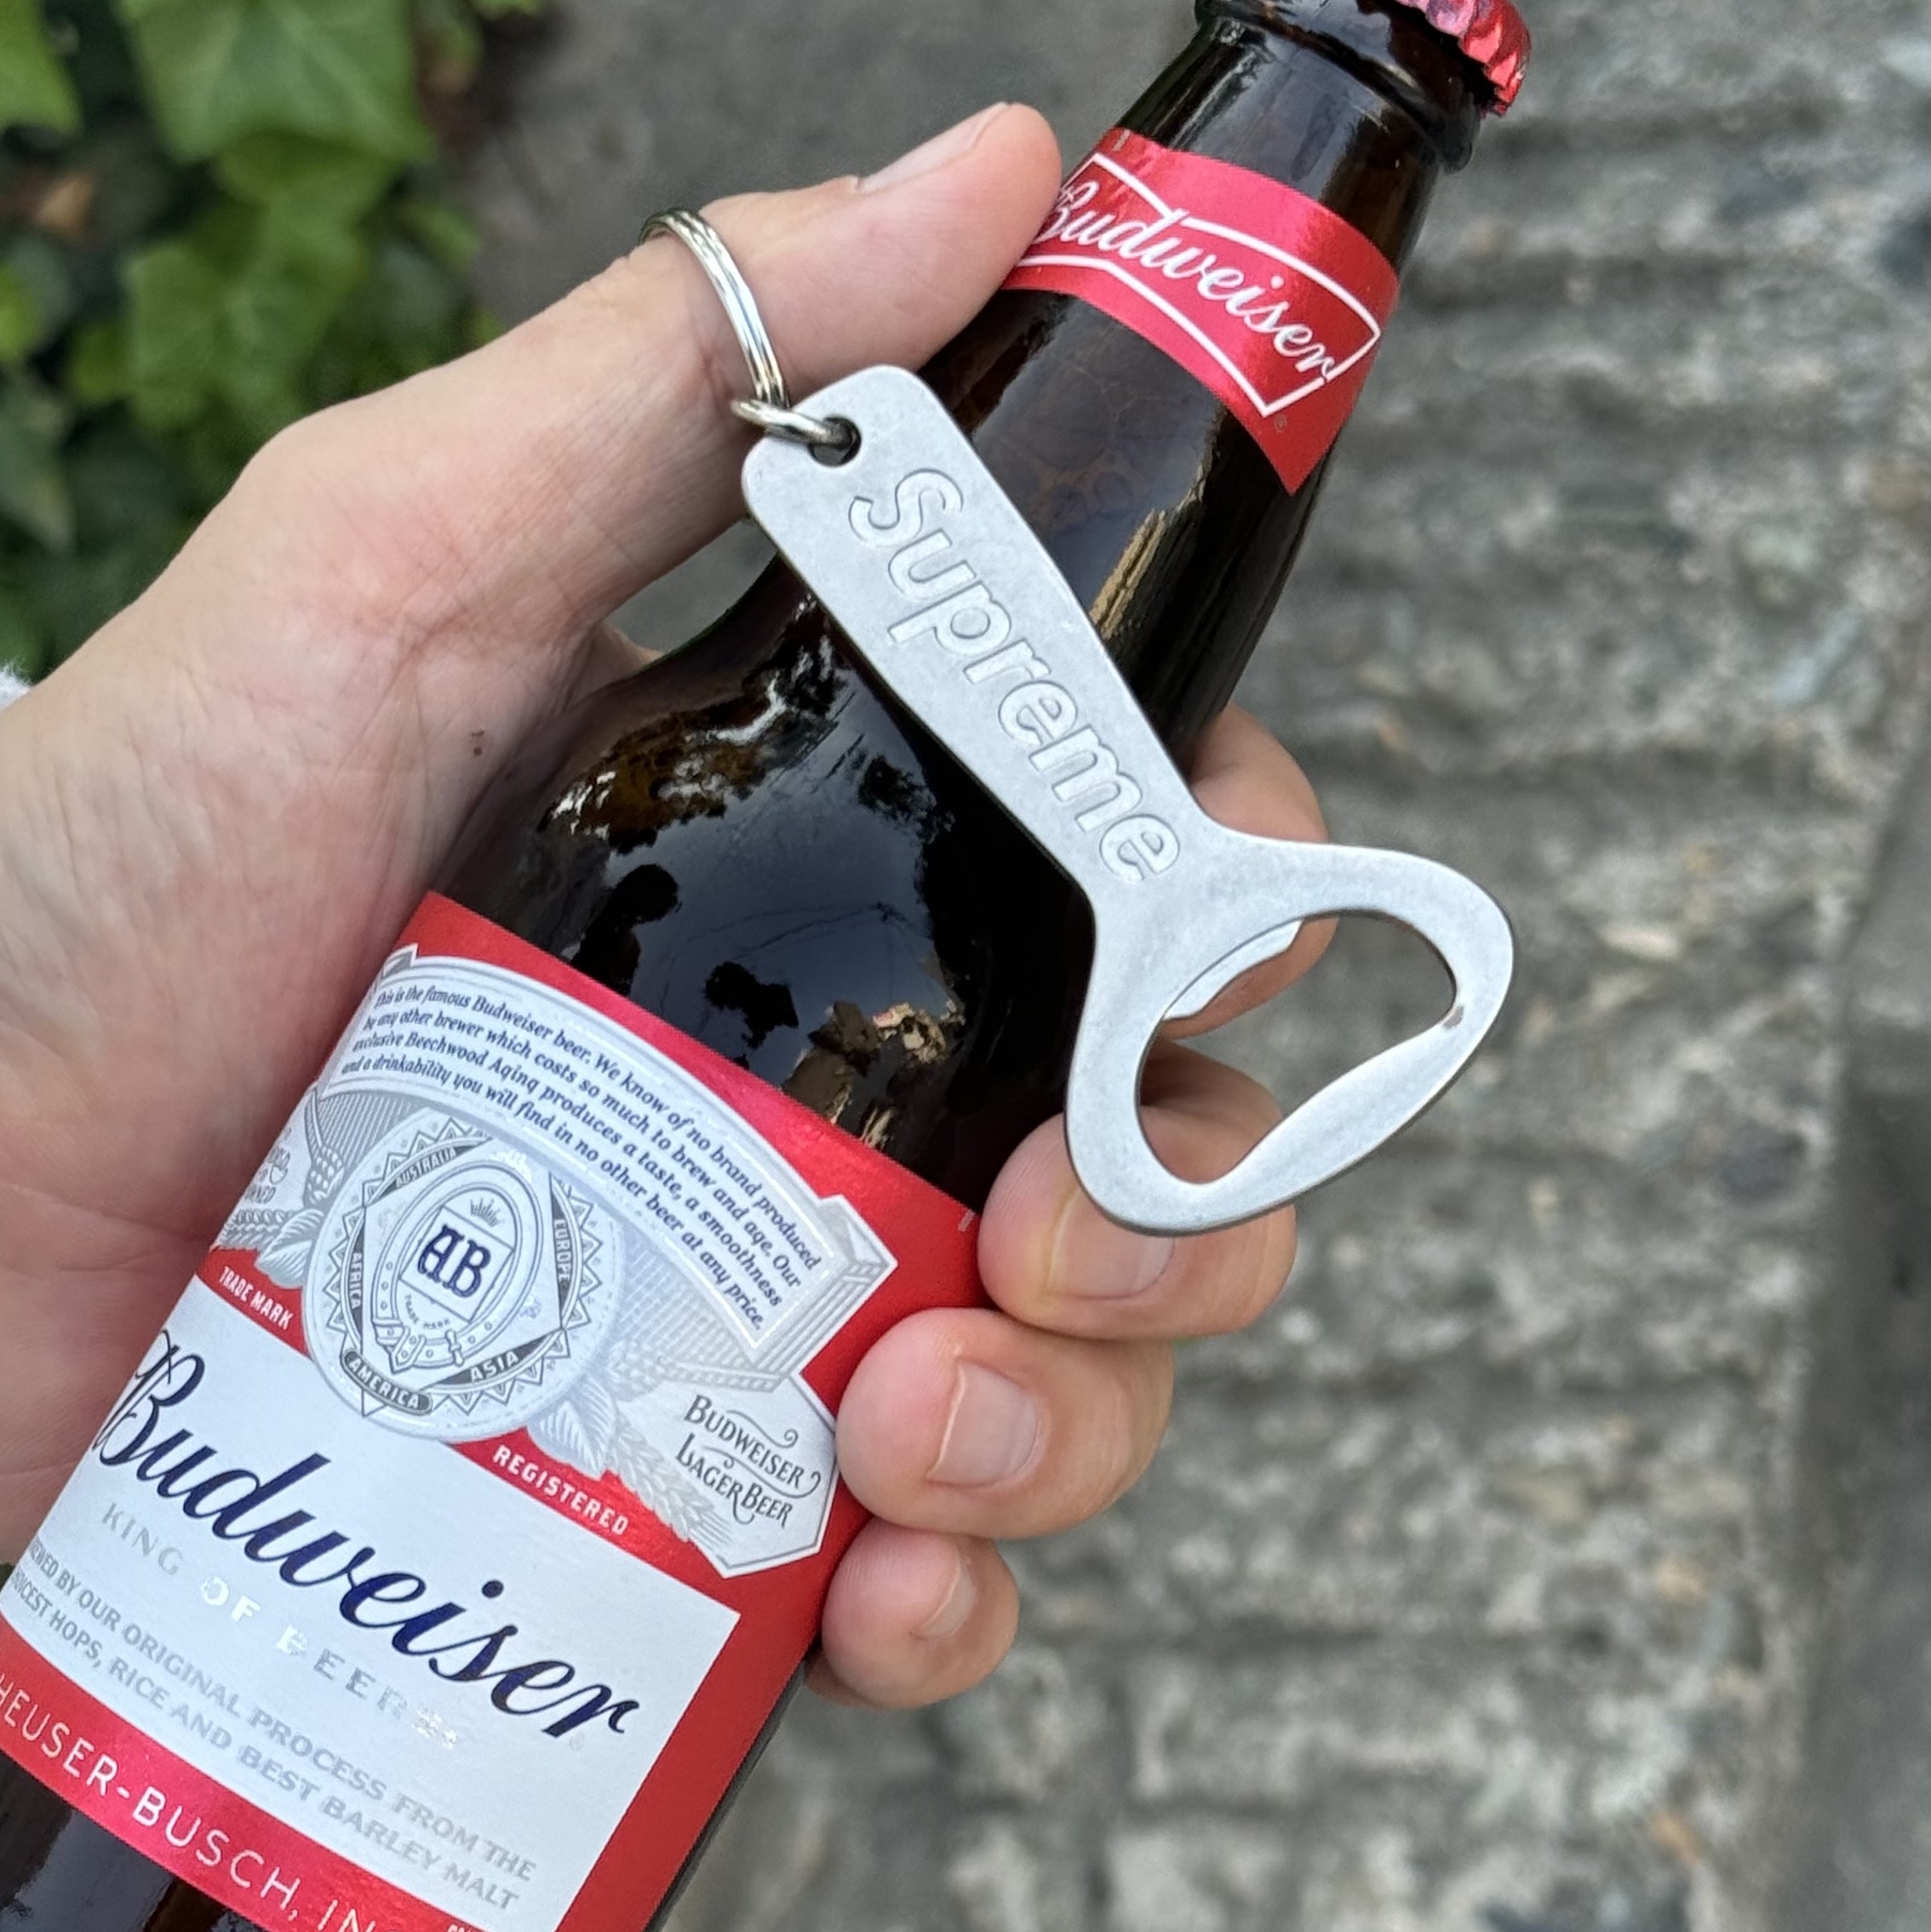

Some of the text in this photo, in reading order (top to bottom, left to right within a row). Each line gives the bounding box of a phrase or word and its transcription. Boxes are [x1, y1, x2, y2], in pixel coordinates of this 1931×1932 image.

[1033, 181, 1338, 381] Budweiser
[848, 467, 1181, 884] Supreme
[376, 1011, 399, 1028] any
[399, 1006, 434, 1026] other
[433, 1011, 484, 1038] brewer
[486, 1029, 532, 1059] which
[534, 1052, 578, 1084] costs
[579, 1077, 601, 1098] so
[601, 1092, 650, 1135] much
[650, 1129, 672, 1150] to
[671, 1144, 717, 1189] brew
[712, 1186, 750, 1221] and
[743, 1220, 774, 1258] age.
[773, 1253, 802, 1288] Our
[394, 986, 405, 1004] is
[405, 984, 424, 1002] the
[421, 984, 472, 1009] famous
[472, 995, 553, 1040] Budweiser
[553, 1029, 591, 1064] beer.
[594, 1053, 622, 1081] We
[620, 1071, 670, 1114] know
[668, 1111, 695, 1132] of
[686, 1126, 712, 1151] no
[710, 1145, 763, 1197] brand
[753, 1195, 822, 1271] produced
[395, 1147, 458, 1188] AUSTRALIA
[404, 1031, 490, 1066] Beechwood
[489, 1057, 541, 1093] Aging
[538, 1086, 623, 1145] produces
[623, 1142, 639, 1158] a
[637, 1151, 684, 1201] taste,
[685, 1196, 701, 1212] a
[697, 1209, 782, 1307] smoothness
[363, 1058, 372, 1070] a
[372, 1052, 453, 1086] drinkability
[452, 1070, 484, 1095] you
[485, 1086, 518, 1111] will
[513, 1100, 556, 1131] find
[553, 1121, 574, 1145] in
[574, 1138, 599, 1162] no
[600, 1158, 647, 1199] other
[645, 1193, 685, 1232] beer
[681, 1230, 704, 1253] at
[699, 1250, 731, 1285] any
[725, 1283, 764, 1330] price.
[219, 1265, 294, 1331] TRADE MARK
[349, 1251, 363, 1310] AFRICA
[417, 1224, 491, 1299] AB
[553, 1218, 572, 1282] EUROPE
[348, 1354, 421, 1411] AMERICA
[468, 1349, 520, 1383] ASIA
[492, 1444, 630, 1536] REGISTERED
[674, 1432, 795, 1530] LAGER BEER
[684, 1393, 805, 1490] BUDWEISER
[90, 1328, 640, 1739] Budweiser
[101, 1501, 184, 1576] KING
[199, 1575, 262, 1622] OF
[49, 1608, 103, 1669] HOPS,
[108, 1654, 170, 1710] RICE
[169, 1702, 234, 1751] AND
[238, 1744, 321, 1802] BEST
[318, 1794, 442, 1872] BARLEY
[443, 1861, 519, 1911] MALT
[54, 1567, 82, 1597] BY
[78, 1589, 122, 1633] OUR
[123, 1621, 242, 1718] ORIGINAL
[248, 1705, 388, 1801] PROCESS
[393, 1792, 479, 1853] FROM
[484, 1839, 536, 1882] THE
